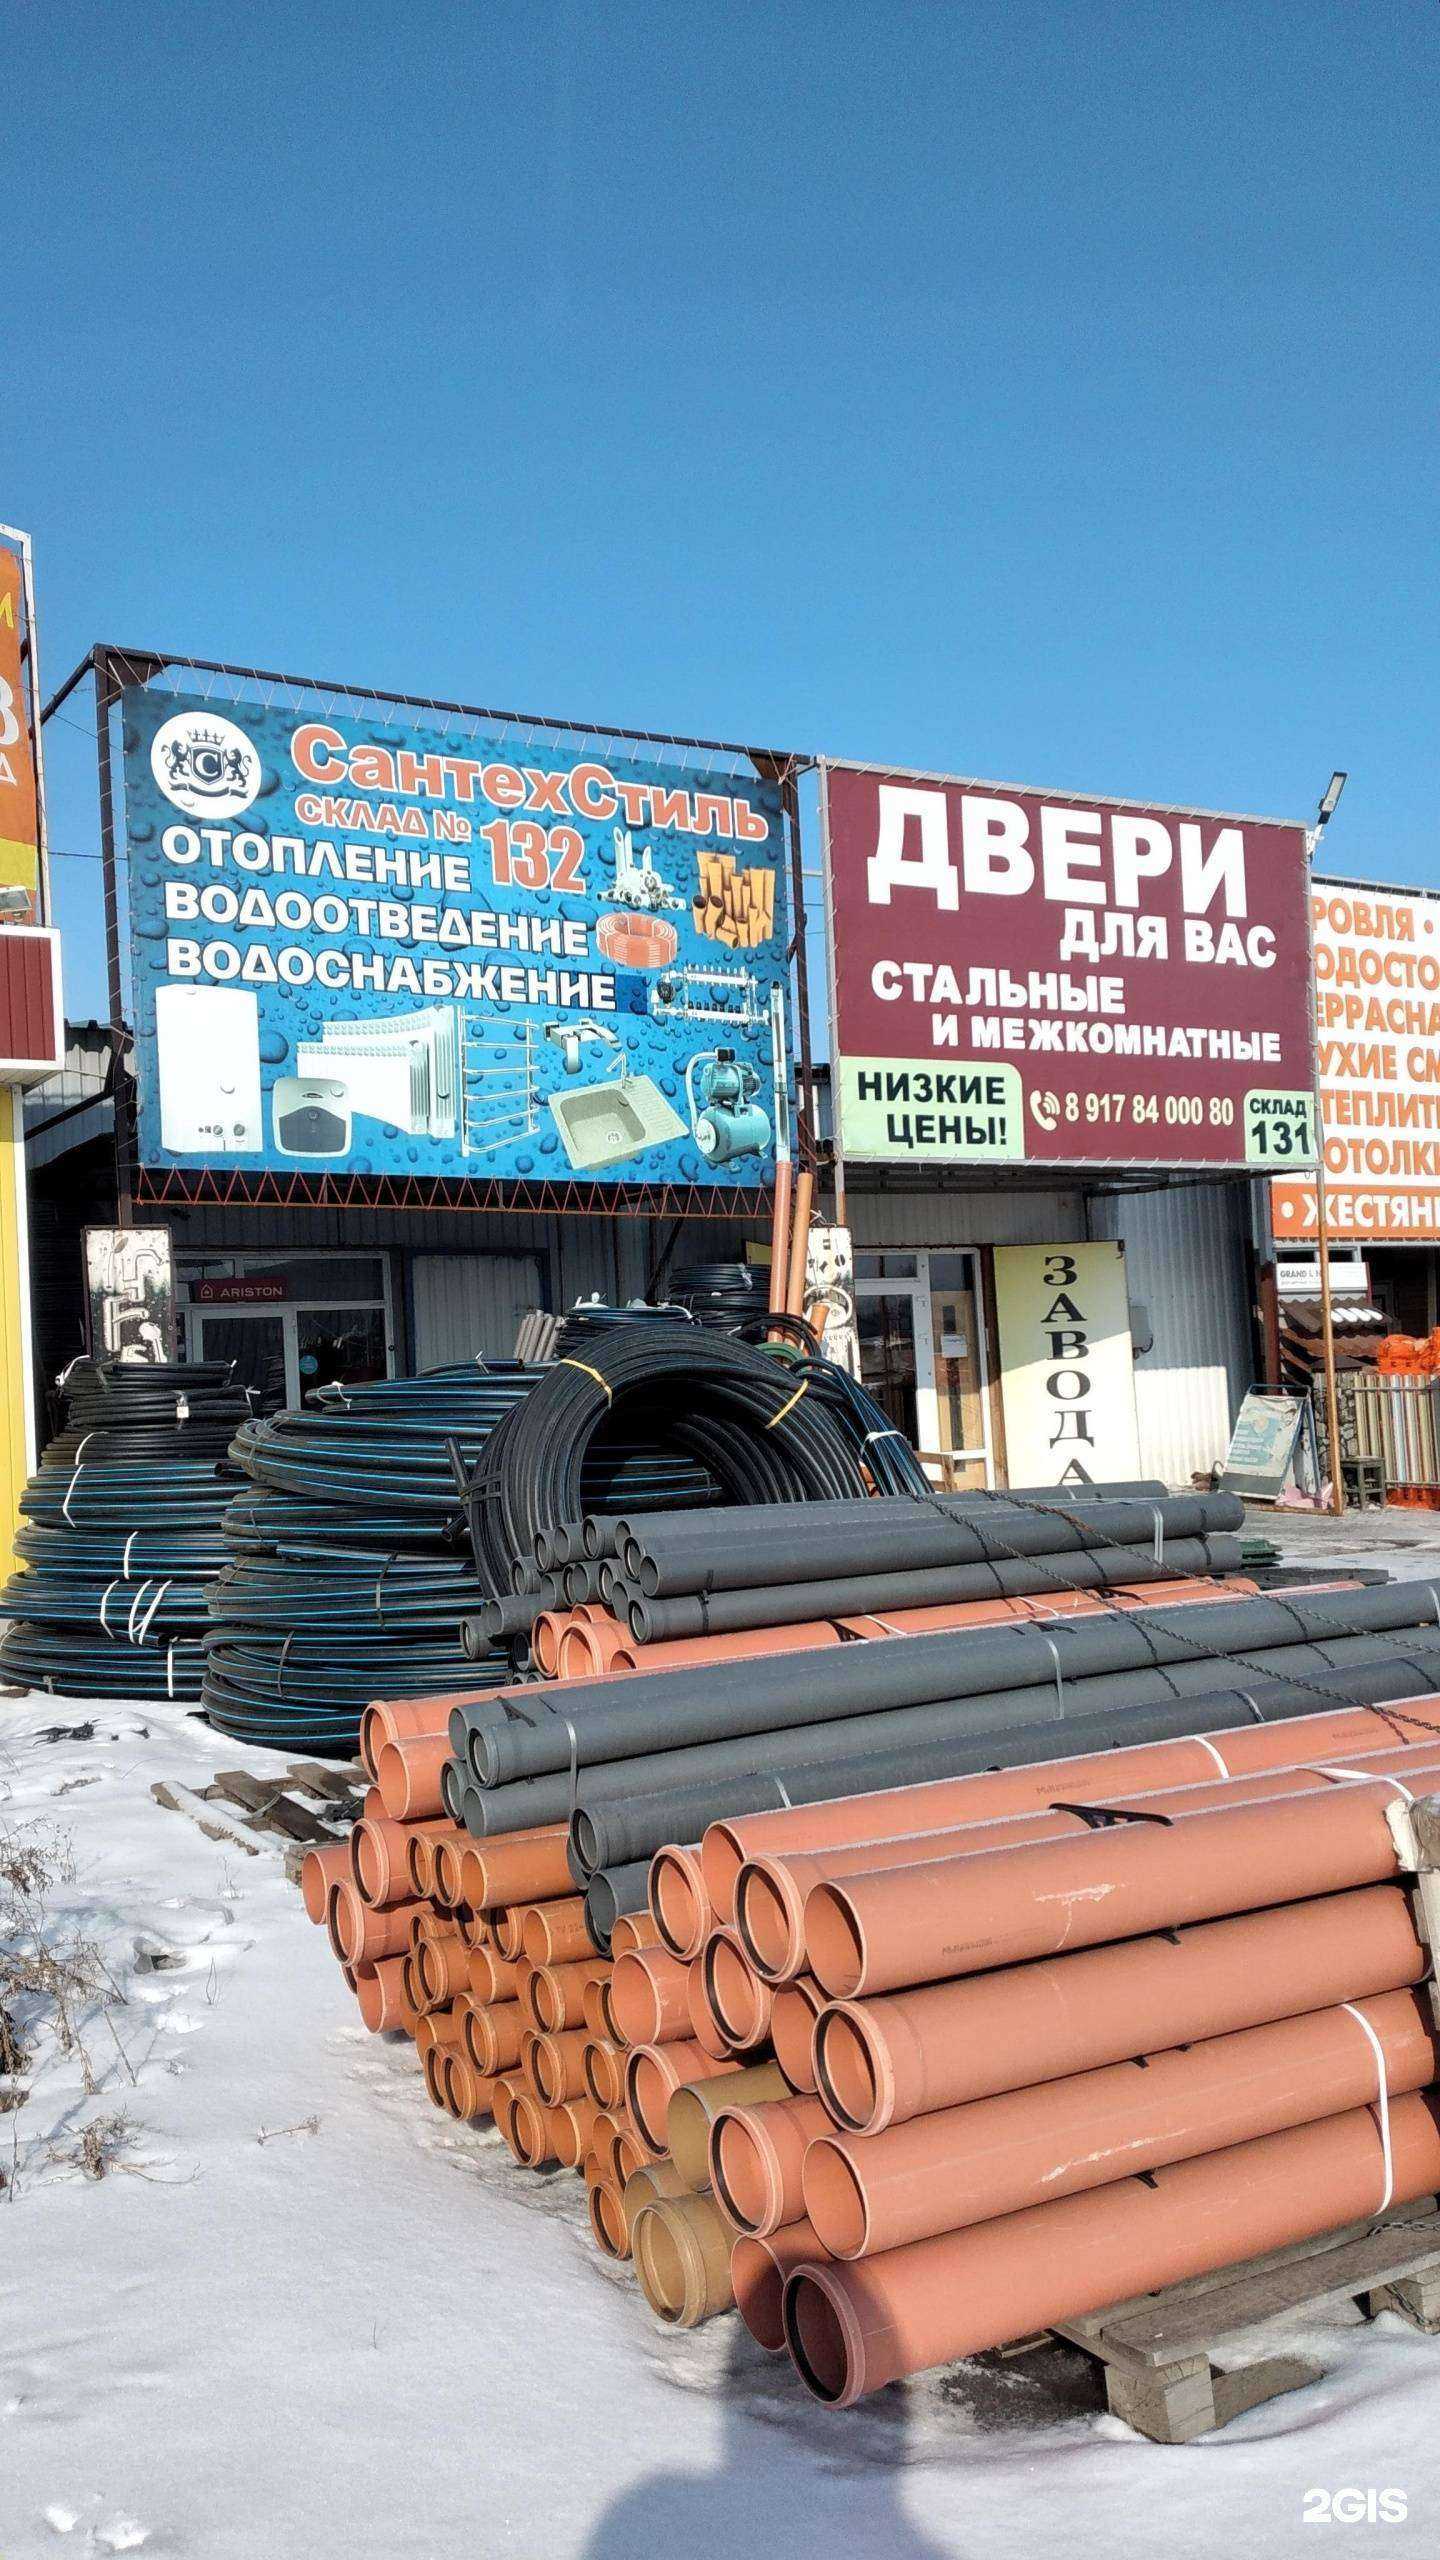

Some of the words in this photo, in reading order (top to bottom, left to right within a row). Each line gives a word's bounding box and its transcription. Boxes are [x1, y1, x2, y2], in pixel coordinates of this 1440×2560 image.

[290, 723, 768, 841] СантехСтиль
[161, 825, 472, 892] ОТОПЛЕНИЕ
[294, 794, 429, 840] СКЛАД
[433, 809, 473, 843] №
[481, 818, 587, 894] 132
[866, 784, 1246, 918] ДВЕРИ
[164, 881, 589, 956] ВОДООТВЕДЕНИЕ
[1060, 908, 1167, 962] ДЛЯ
[1184, 922, 1277, 969] ВАС
[1312, 896, 1415, 941] РОВЛЯ
[166, 938, 616, 1009] ВОДОСНАБЖЕНИЕ
[871, 961, 1126, 1015] СТАЛЬНЫЕ
[1315, 943, 1440, 990] ОДОСТО
[1317, 992, 1440, 1036] ЕРРАСНА
[932, 1014, 959, 1047] И
[971, 1015, 1282, 1062] МЕЖКОМНАТНЫЕ
[1317, 1041, 1397, 1079] УХИЕ
[857, 1071, 1006, 1105] НИЗКИЕ
[1065, 1092, 1079, 1122] 8
[1085, 1093, 1125, 1123] 917
[1132, 1095, 1160, 1124] 84
[1165, 1095, 1202, 1126] 000
[1209, 1097, 1234, 1126] 80
[1249, 1098, 1307, 1118] СКЛАД
[1320, 1089, 1440, 1128] ТЕПЛИТ
[886, 1114, 1008, 1149] ЦЕНЫ!
[1252, 1120, 1310, 1155] 131
[1323, 1136, 1440, 1175] ОТОЛК
[220, 1286, 283, 1298] ARISTON
[1040, 1255, 1096, 1486] ЗАВОДА
